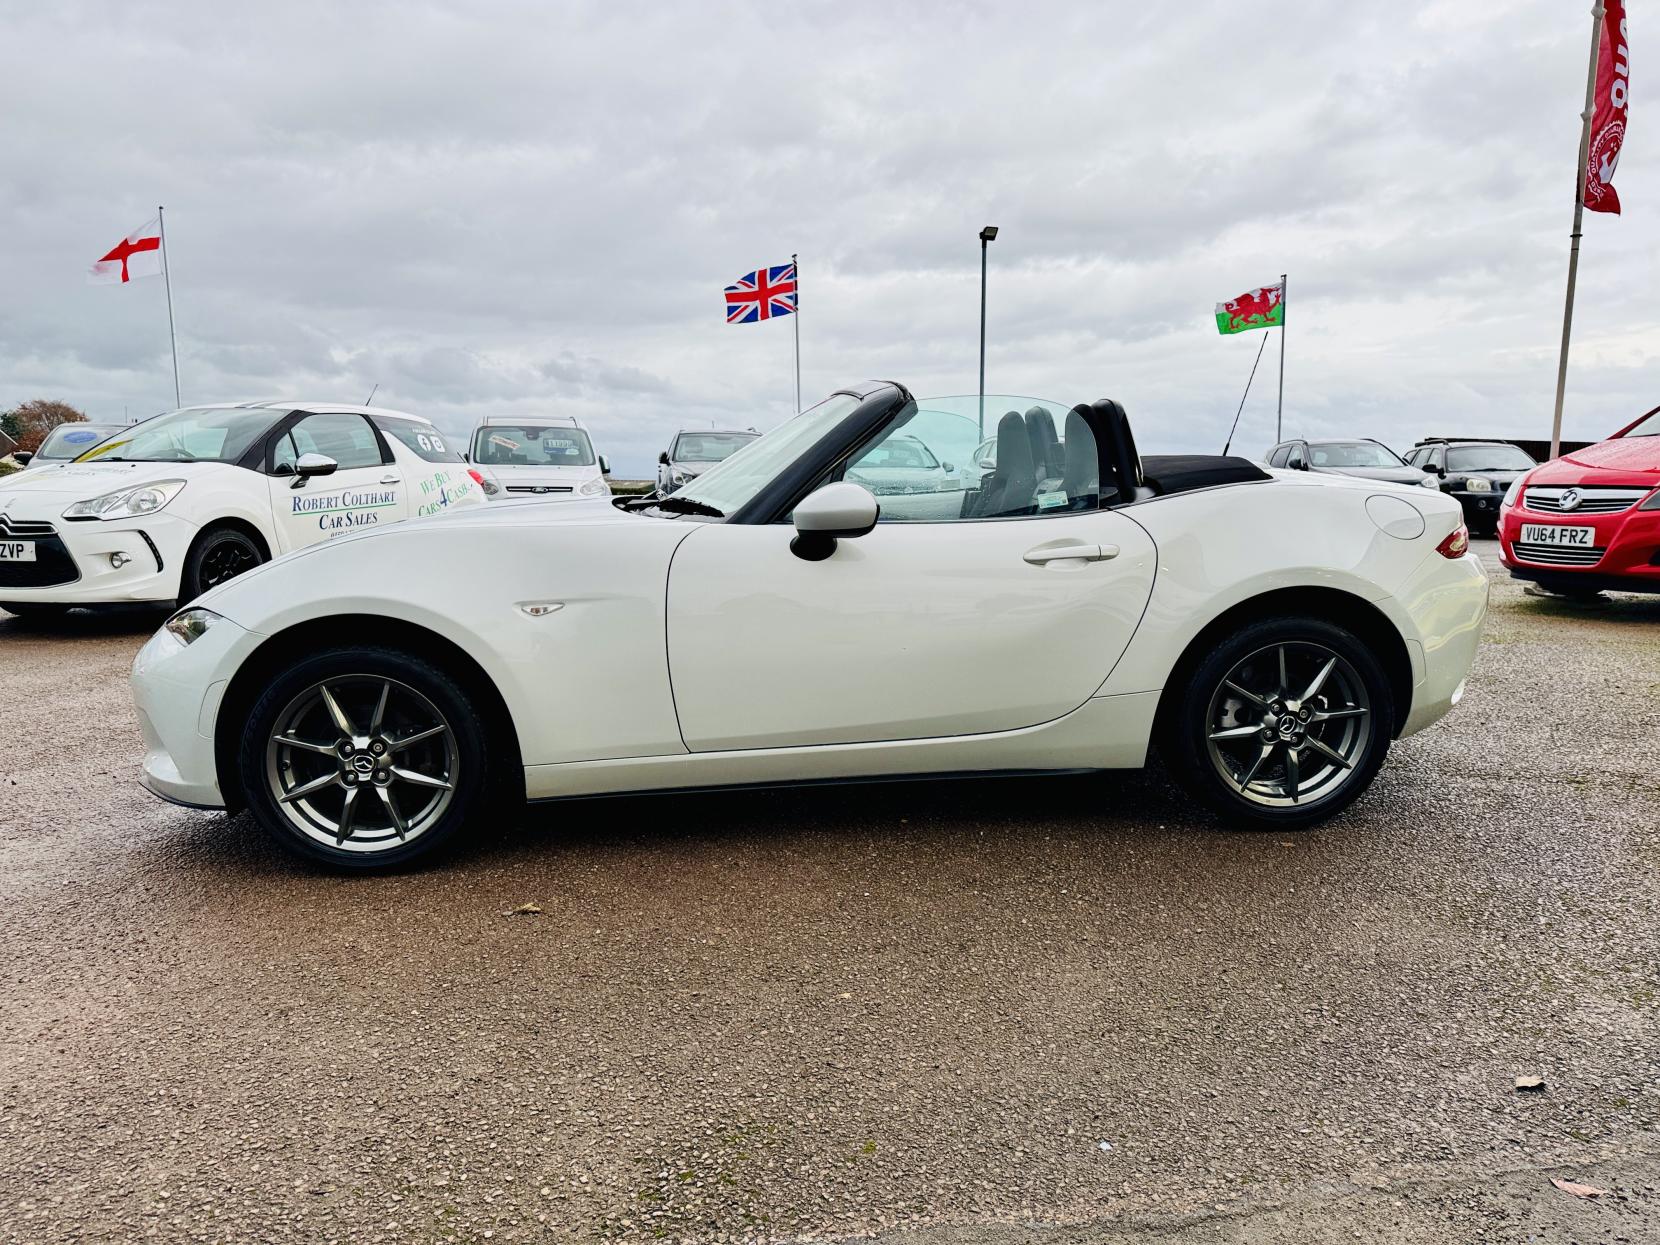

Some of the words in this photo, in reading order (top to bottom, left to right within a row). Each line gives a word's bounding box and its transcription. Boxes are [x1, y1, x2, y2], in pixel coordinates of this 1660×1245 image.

[292, 496, 340, 512] ROBERT
[342, 491, 396, 507] COLTHART
[319, 514, 343, 530] CAR
[345, 511, 378, 527] SALES
[1526, 526, 1556, 542] VU64
[1559, 528, 1589, 544] FRZ
